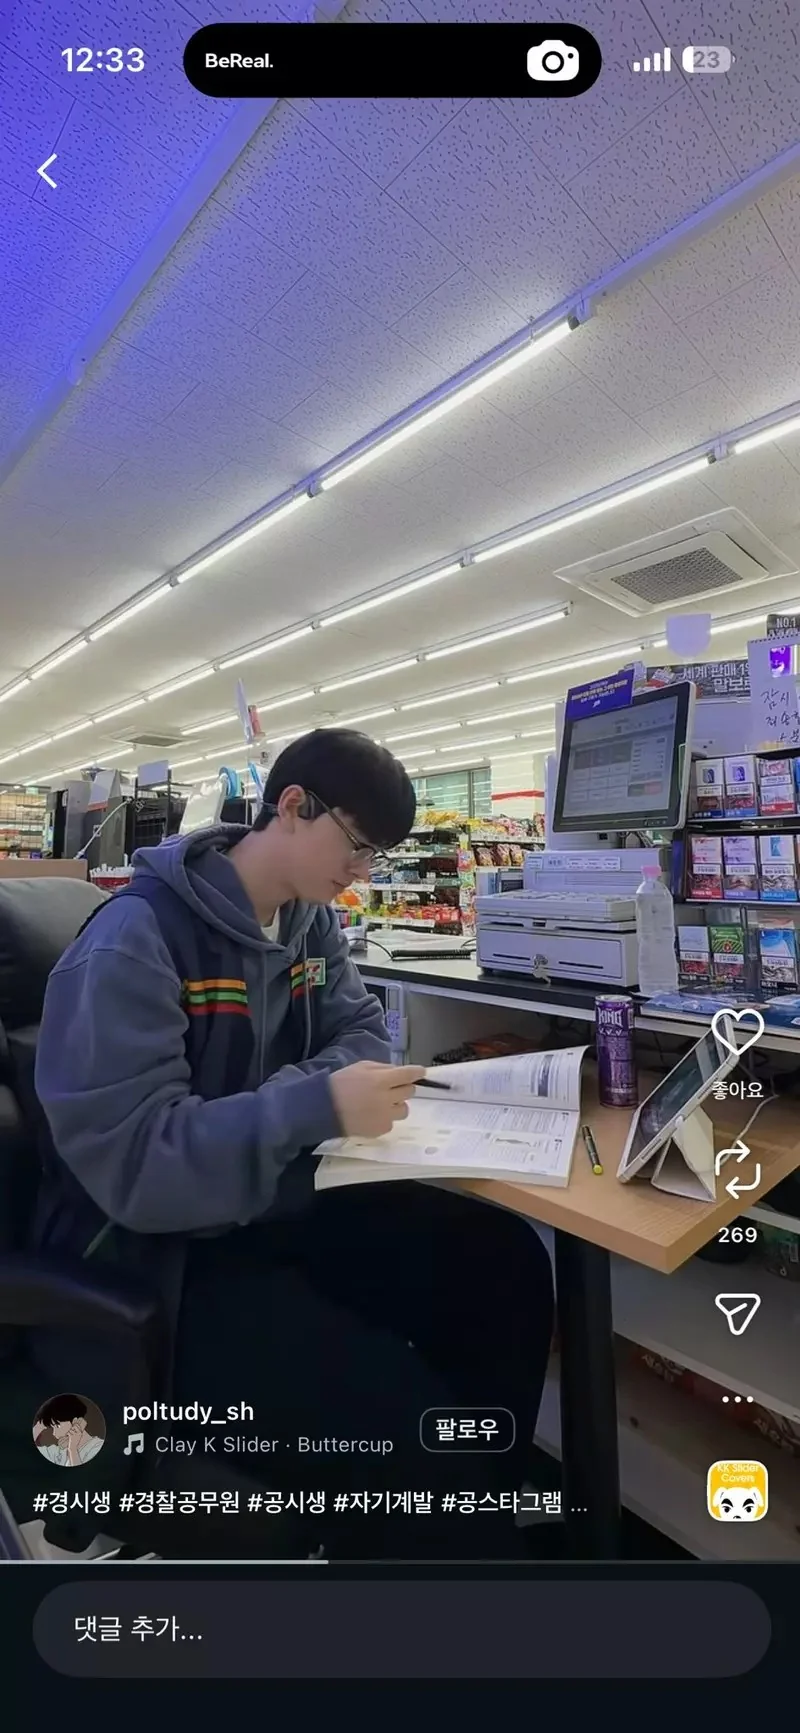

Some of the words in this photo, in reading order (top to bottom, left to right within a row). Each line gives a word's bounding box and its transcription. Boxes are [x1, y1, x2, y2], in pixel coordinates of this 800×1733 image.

[776, 617, 796, 629] NO.1
[680, 665, 708, 680] 세계
[711, 663, 736, 678] 판매
[760, 688, 790, 711] 잠시
[597, 1007, 623, 1027] KING
